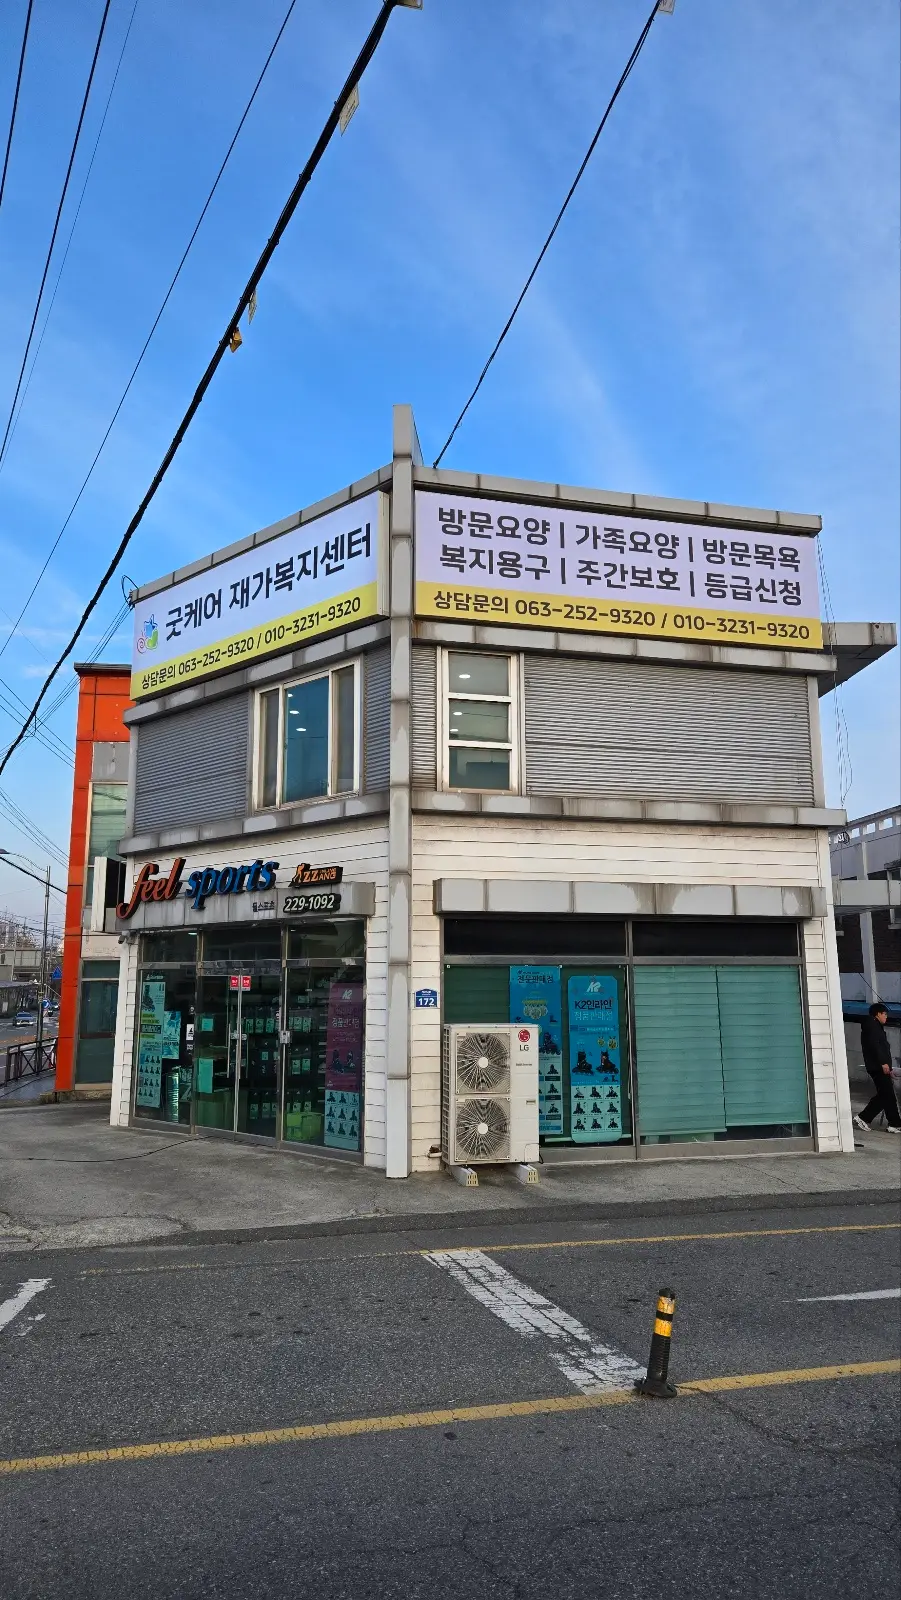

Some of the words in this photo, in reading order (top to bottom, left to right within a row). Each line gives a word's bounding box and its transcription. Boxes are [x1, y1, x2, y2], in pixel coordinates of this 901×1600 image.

[437, 507, 551, 546] 방문요양
[576, 524, 680, 560] 가족요양
[702, 537, 801, 573] 방문목욕
[165, 588, 223, 642] 굿케어
[228, 522, 371, 610] 재가복지센터
[439, 544, 551, 581] 복지용구
[576, 558, 681, 592] 주간보호
[703, 572, 802, 606] 등급신청
[141, 664, 177, 690] 상담문의
[178, 636, 254, 676] 063-252-9320
[264, 596, 361, 645] 010-3231-9320
[433, 590, 509, 614] 상담문의
[514, 599, 656, 627] 063-252-9320
[673, 613, 810, 640] 010-3231-9320
[116, 857, 186, 919] feel
[184, 859, 280, 911] sports
[285, 894, 335, 911] 229-1092
[418, 997, 435, 1006] 172
[574, 999, 613, 1010] K2인라인
[519, 1044, 530, 1052] LG
